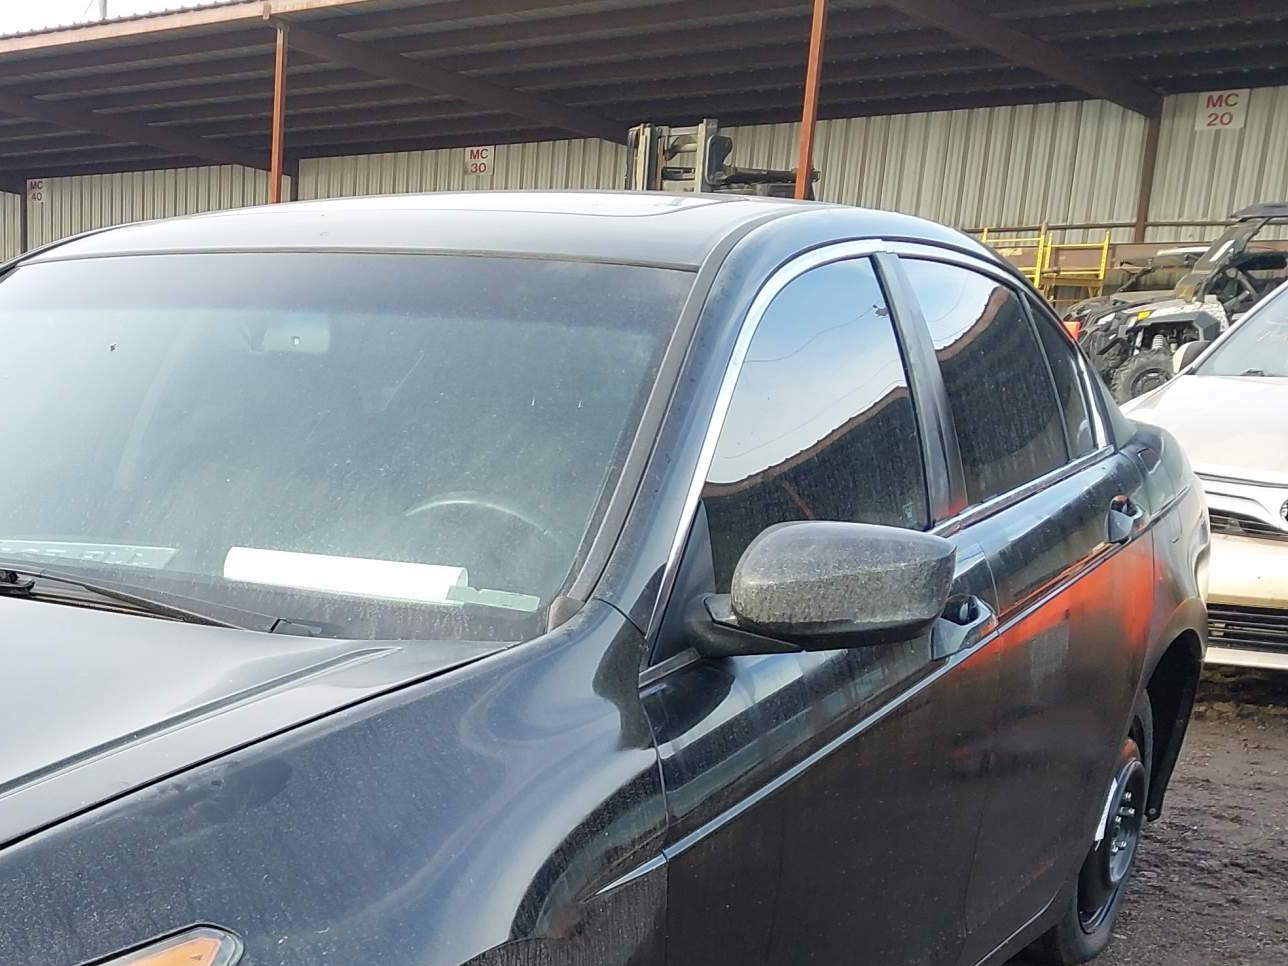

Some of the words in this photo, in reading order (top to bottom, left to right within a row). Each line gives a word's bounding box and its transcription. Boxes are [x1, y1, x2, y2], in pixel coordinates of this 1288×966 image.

[1206, 93, 1239, 108] MC
[1207, 112, 1233, 127] 20
[470, 148, 489, 160] MC
[471, 162, 487, 173] 30
